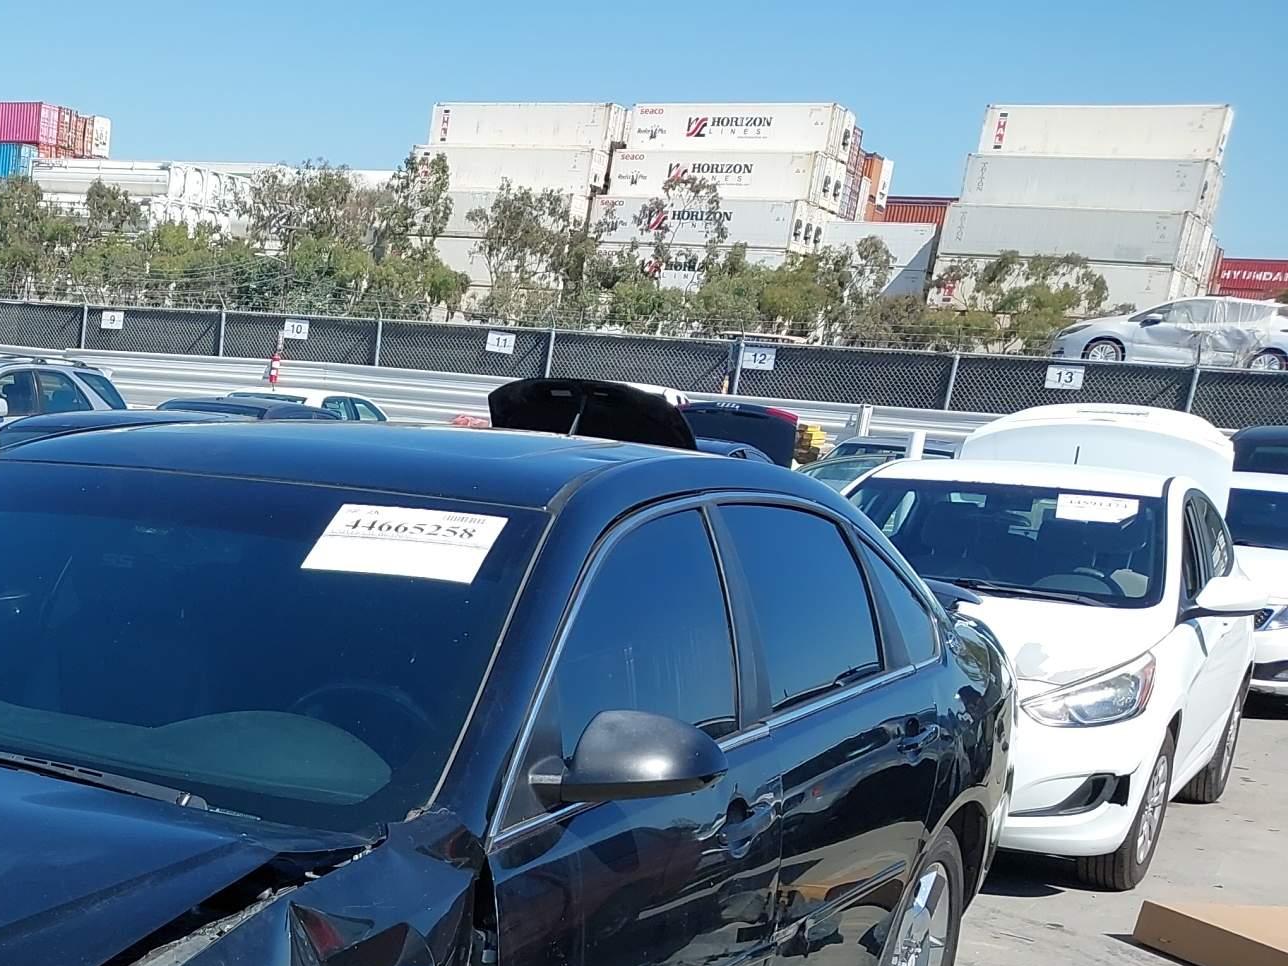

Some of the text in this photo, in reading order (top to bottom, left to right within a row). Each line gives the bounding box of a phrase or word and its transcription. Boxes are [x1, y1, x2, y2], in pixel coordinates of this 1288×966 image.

[640, 107, 664, 115] seaco
[710, 116, 773, 127] HORIZON
[620, 153, 645, 161] seaco
[691, 162, 754, 174] HORIZON
[671, 209, 733, 222] HORIZON
[109, 314, 116, 325] 9
[291, 323, 303, 335] 10
[495, 336, 508, 348] 11
[751, 352, 767, 365] 12
[1056, 370, 1074, 384] 13
[345, 517, 477, 540] 44665258
